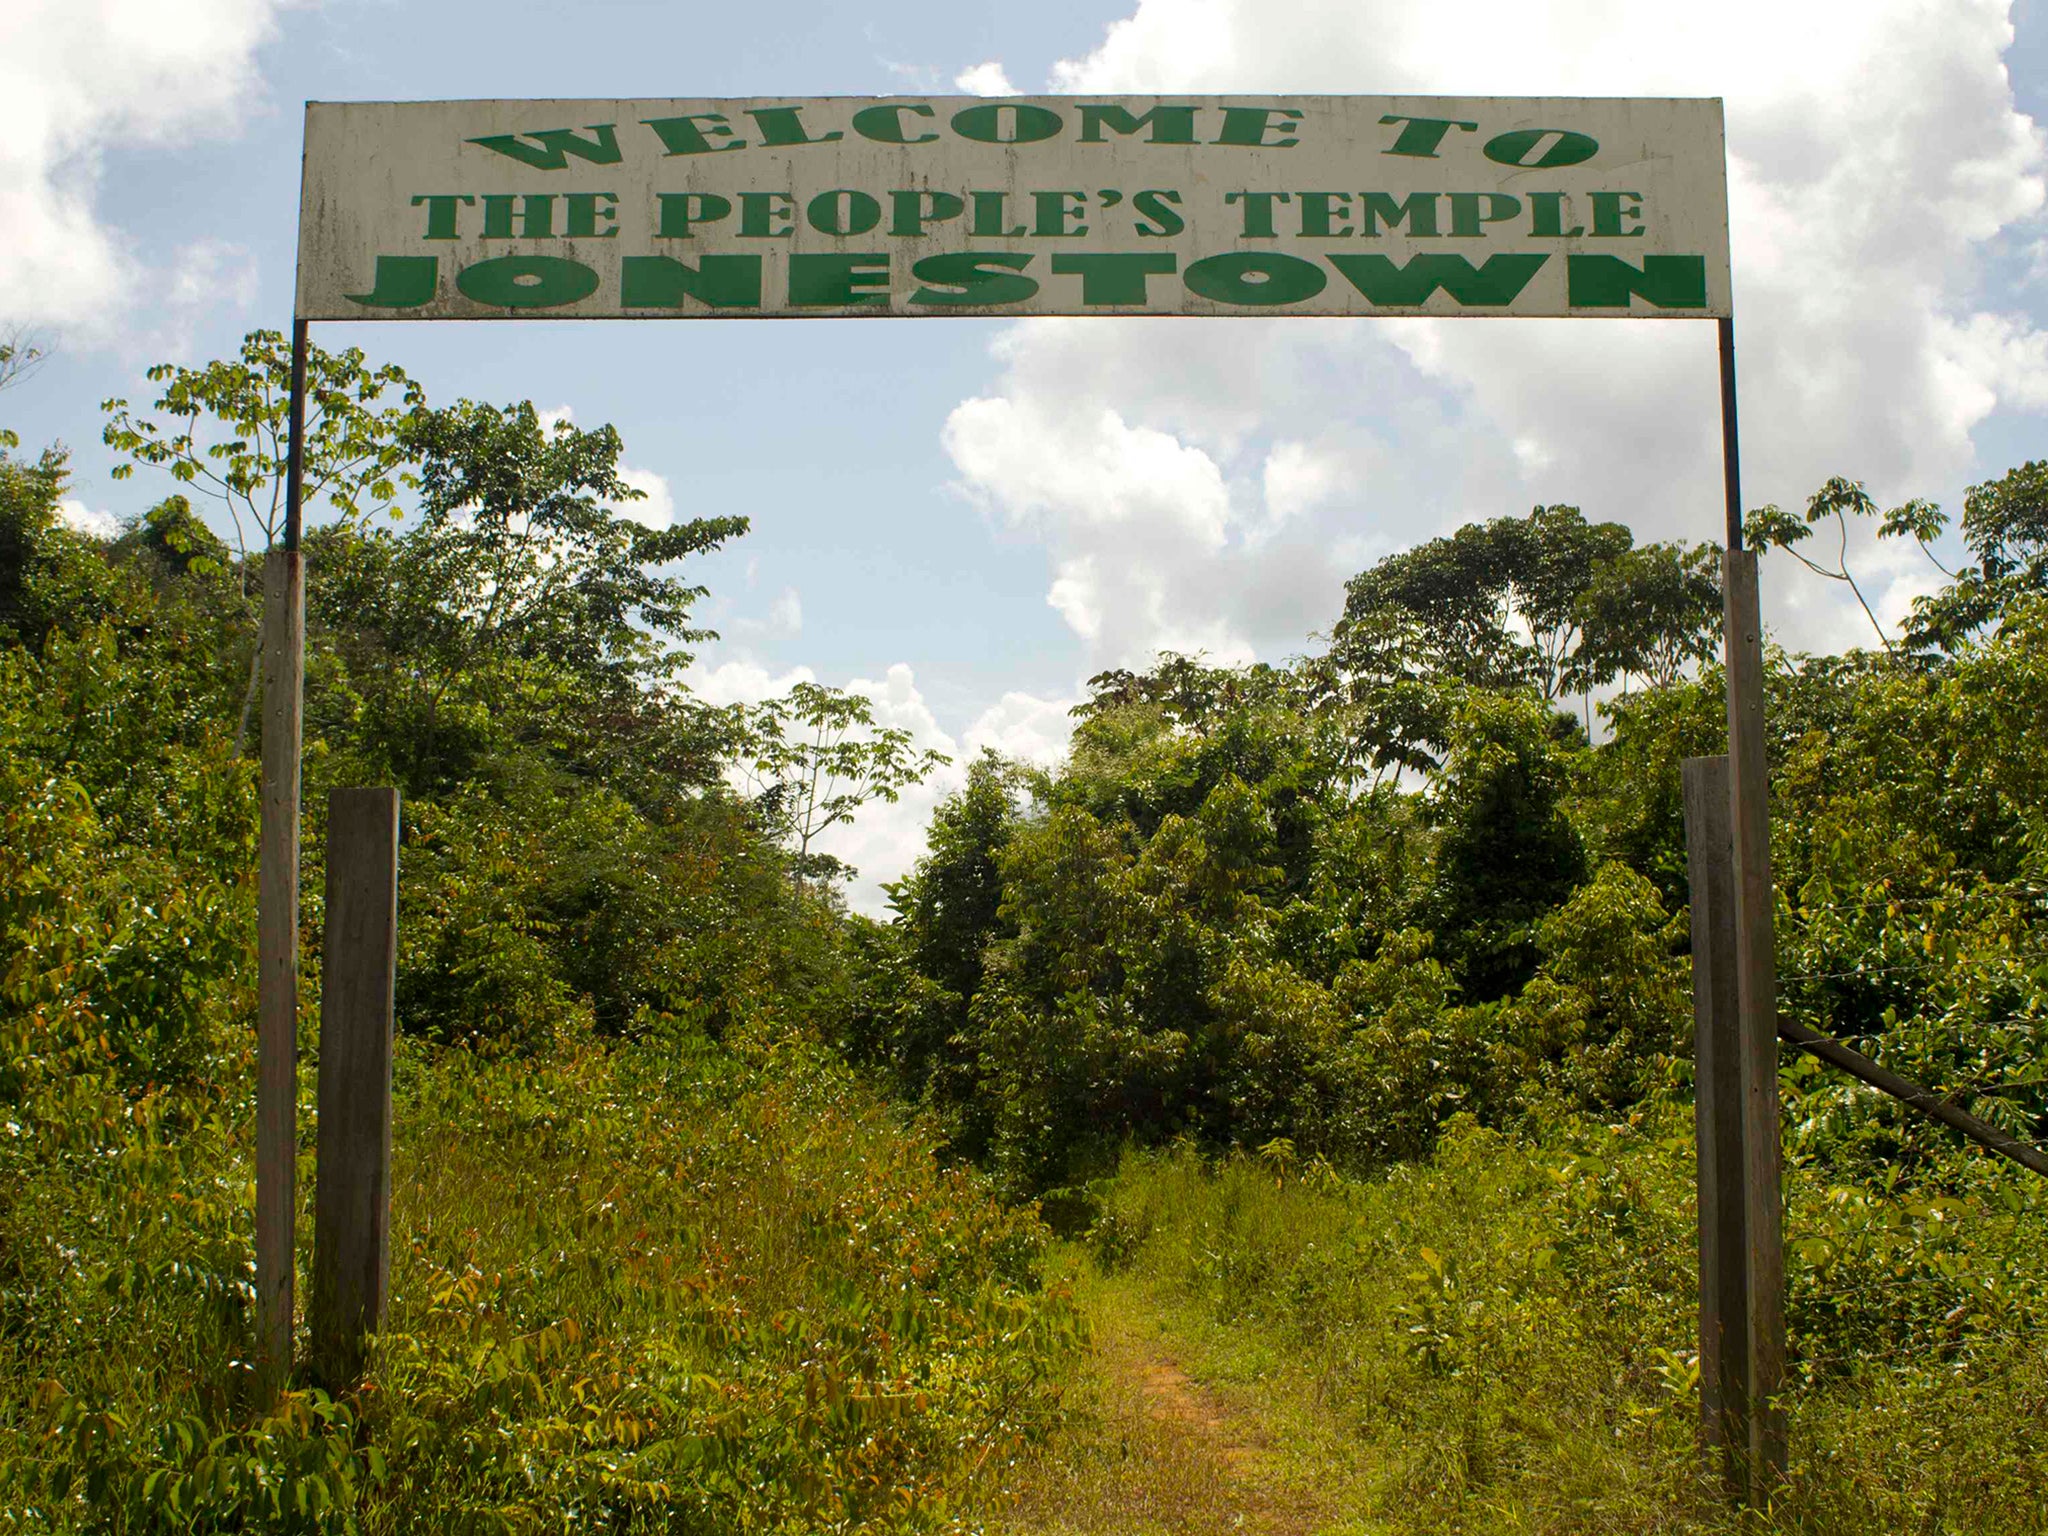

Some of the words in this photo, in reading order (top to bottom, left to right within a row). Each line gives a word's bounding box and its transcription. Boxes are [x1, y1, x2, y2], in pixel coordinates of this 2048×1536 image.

[464, 103, 1305, 171] WELCOME
[1379, 114, 1600, 168] TO
[411, 191, 620, 240] THE
[655, 189, 1185, 237] PEOPLE’S
[1224, 191, 1646, 238] TEMPLE
[343, 251, 1708, 308] JONESTOWN
